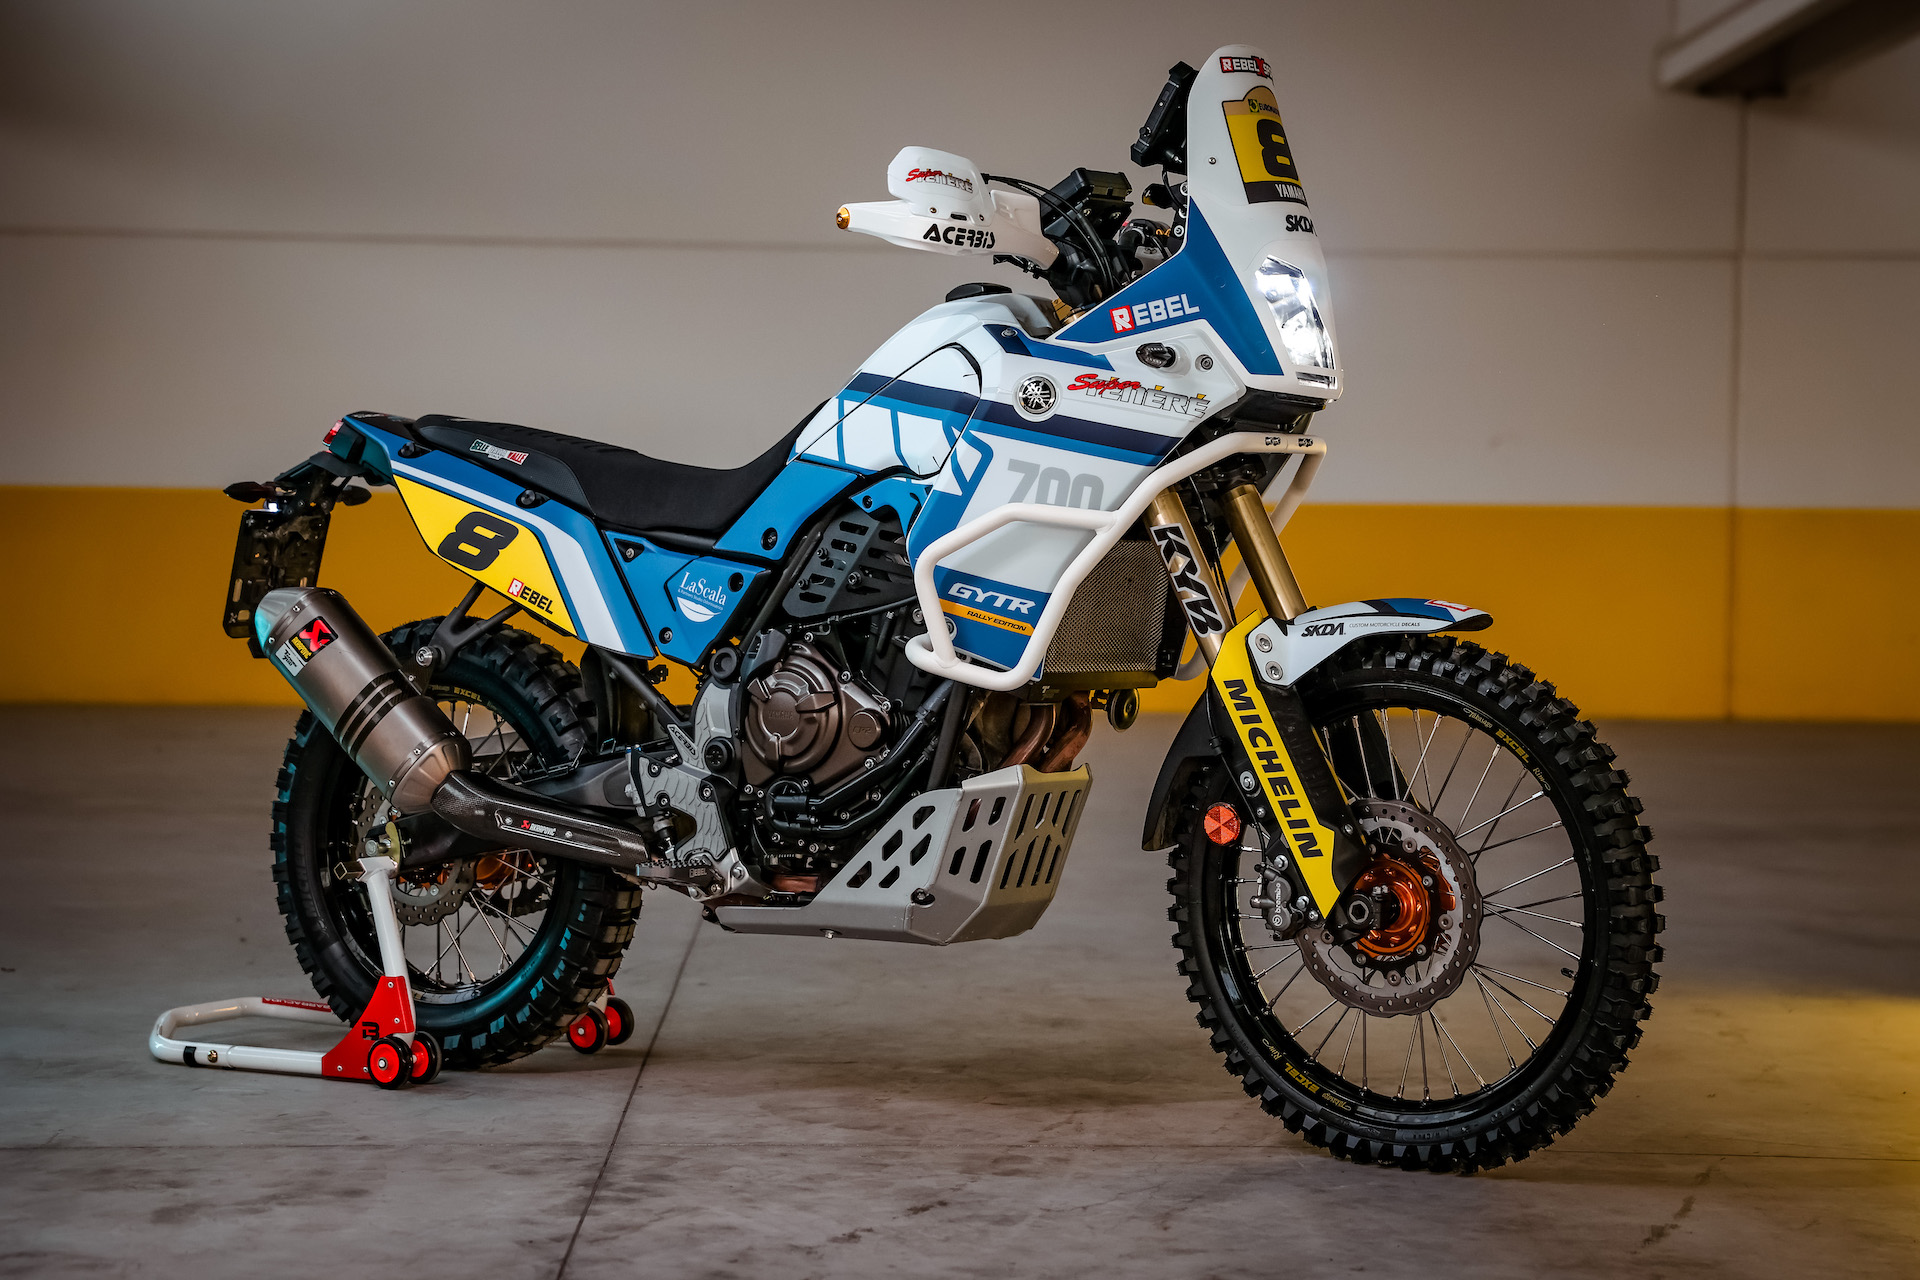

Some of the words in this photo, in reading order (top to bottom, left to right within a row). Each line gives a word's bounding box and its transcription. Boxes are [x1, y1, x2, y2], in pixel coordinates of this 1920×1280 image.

[1257, 119, 1299, 181] 8
[923, 223, 996, 249] ACERBIS
[1110, 293, 1200, 333] REBEL
[1067, 374, 1141, 395] Super
[1007, 458, 1104, 511] 700
[438, 511, 519, 571] 8
[507, 578, 553, 615] REBEL
[679, 571, 727, 606] LaScala
[948, 582, 1036, 614] GYTR
[1150, 523, 1225, 638] KYB
[966, 610, 994, 622] RALLY
[993, 618, 1027, 631] EDITION
[1301, 623, 1345, 637] SKDA
[453, 686, 482, 702] EXCEL
[1495, 729, 1530, 764] EXCEL
[1223, 679, 1323, 858] MICHELIN
[1284, 1062, 1320, 1094] EXCEL
